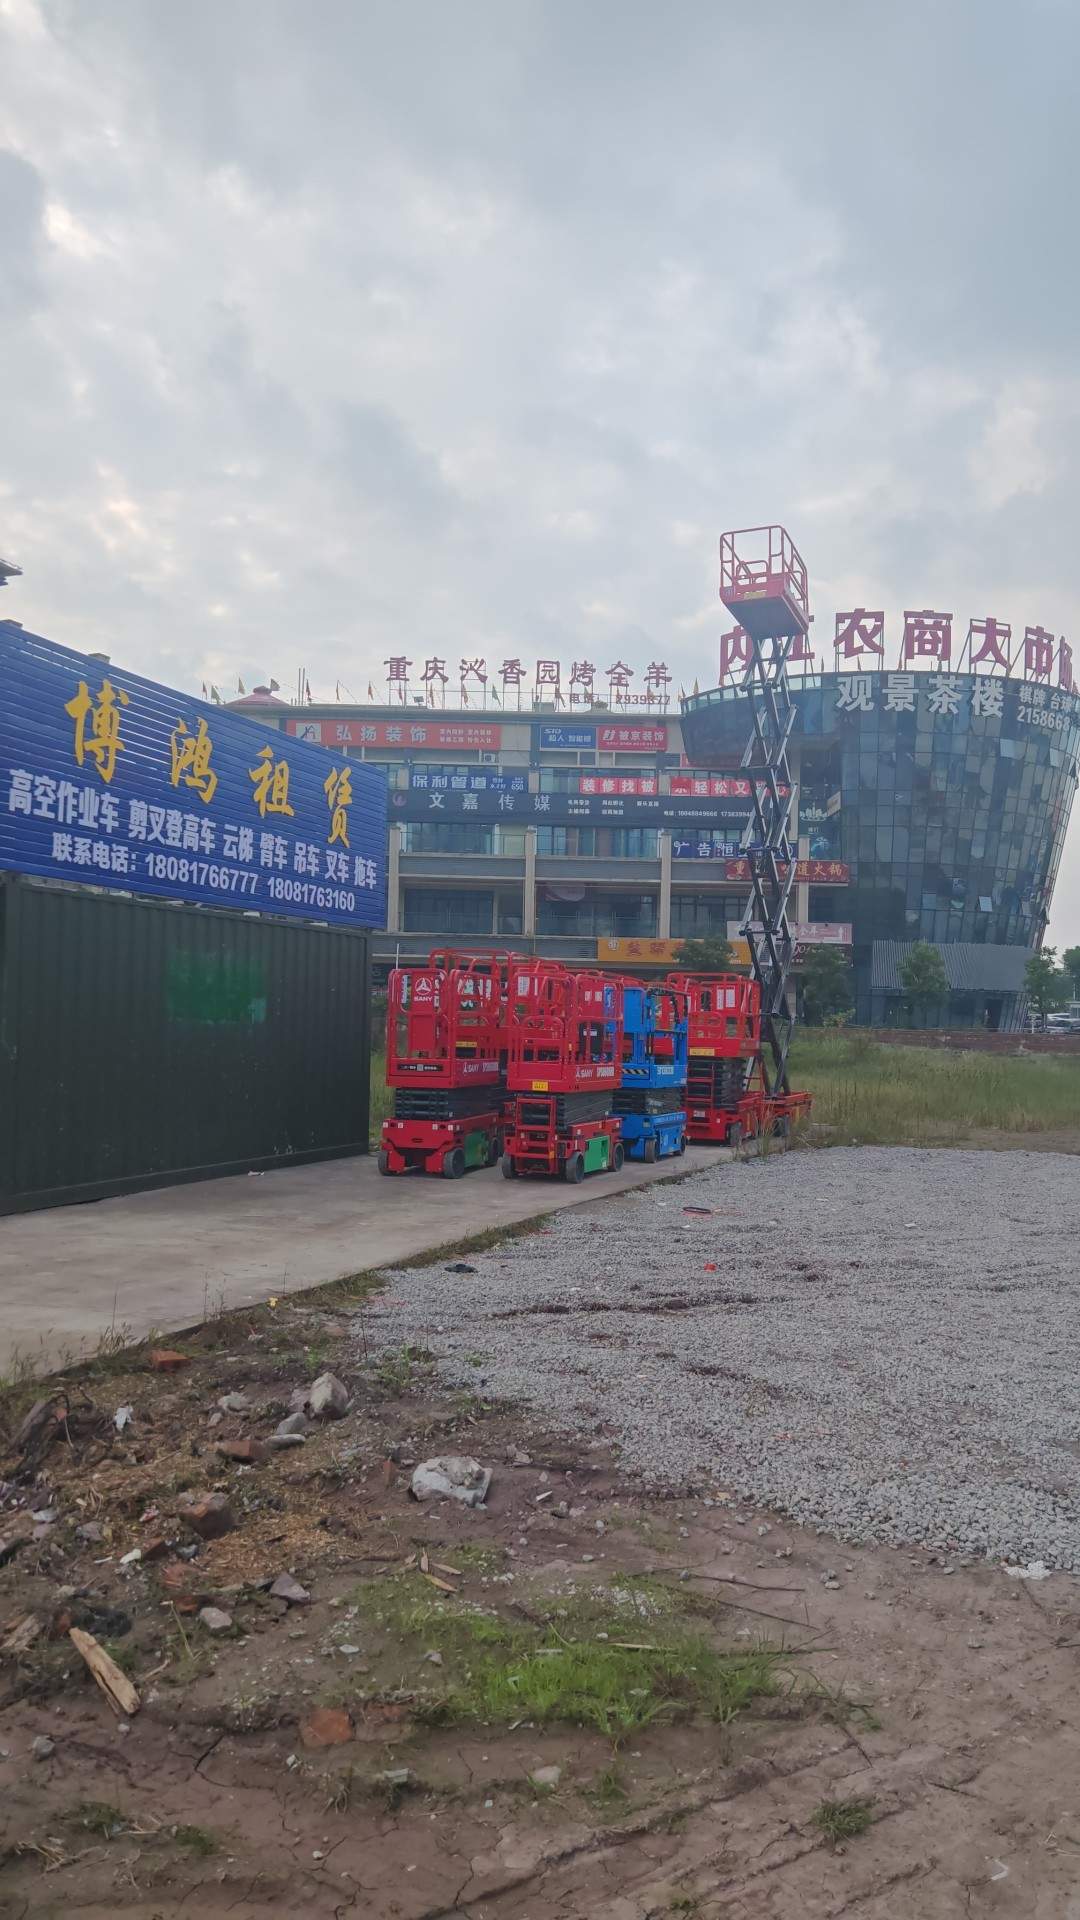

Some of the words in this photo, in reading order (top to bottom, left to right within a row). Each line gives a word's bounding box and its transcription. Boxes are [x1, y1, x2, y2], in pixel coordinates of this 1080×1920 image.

[384, 656, 672, 688] 重庆沁香园烤全羊
[836, 674, 1005, 718] 观景茶楼
[1019, 685, 1047, 707] 棋牌
[1017, 705, 1071, 732] 2158668
[336, 724, 428, 743] 弘扬装饰
[64, 679, 352, 848] 博鸿租赁
[412, 775, 487, 790] 保利管道
[429, 791, 551, 811] 文嘉传媒
[8, 769, 120, 834] 高空作业车
[128, 799, 216, 854] 剪叉登高车
[223, 823, 253, 862] 云梯
[259, 833, 288, 870] 臂车
[294, 841, 320, 877] 吊车
[324, 849, 349, 884] 叉车
[51, 832, 138, 873] 联系电话：
[145, 853, 259, 894] 18081766777
[267, 877, 355, 911] 18081763160
